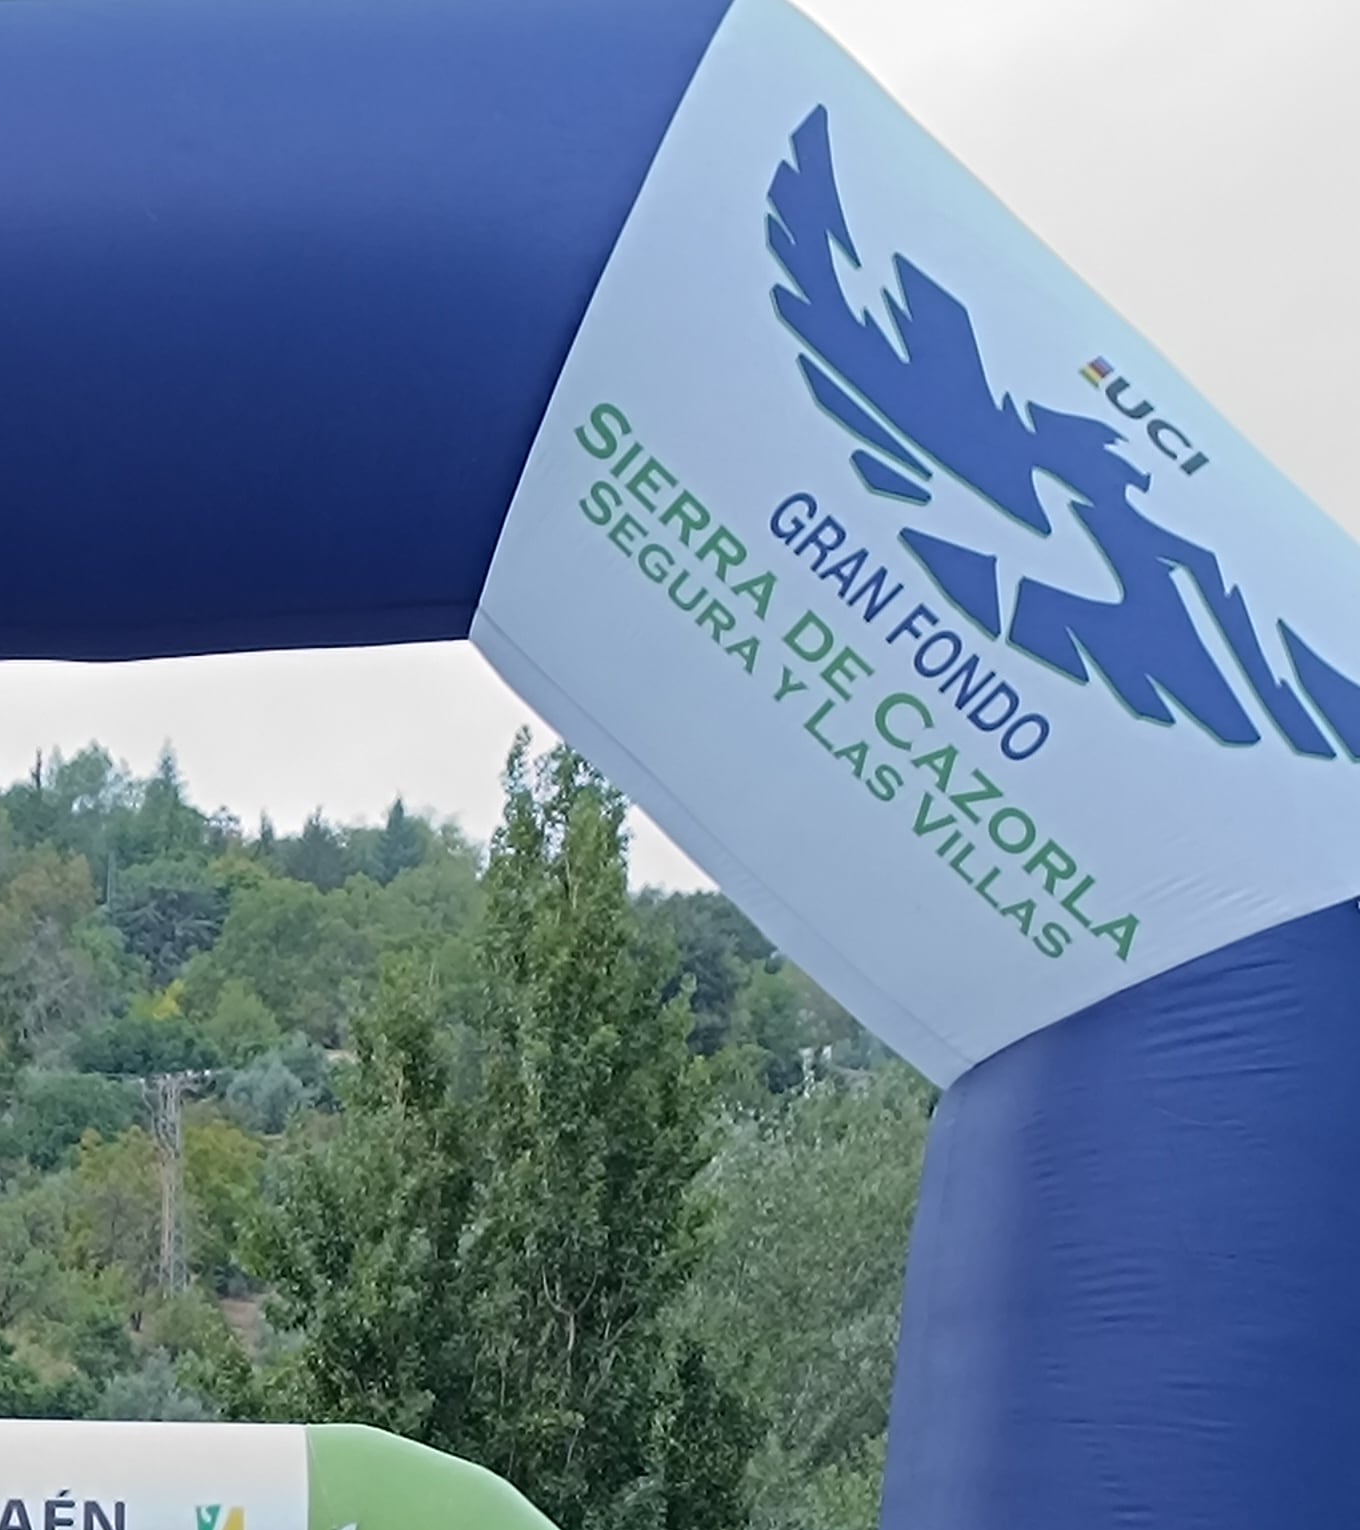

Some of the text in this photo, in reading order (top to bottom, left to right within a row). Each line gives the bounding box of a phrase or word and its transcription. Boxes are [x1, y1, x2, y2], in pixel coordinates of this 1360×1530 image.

[1103, 376, 1211, 476] UCI
[574, 401, 1144, 964] SIERRA DE CAZORLA
[577, 480, 1074, 960] SEGURA Y LAS VILLAS
[767, 489, 1052, 763] GRAN FONDO
